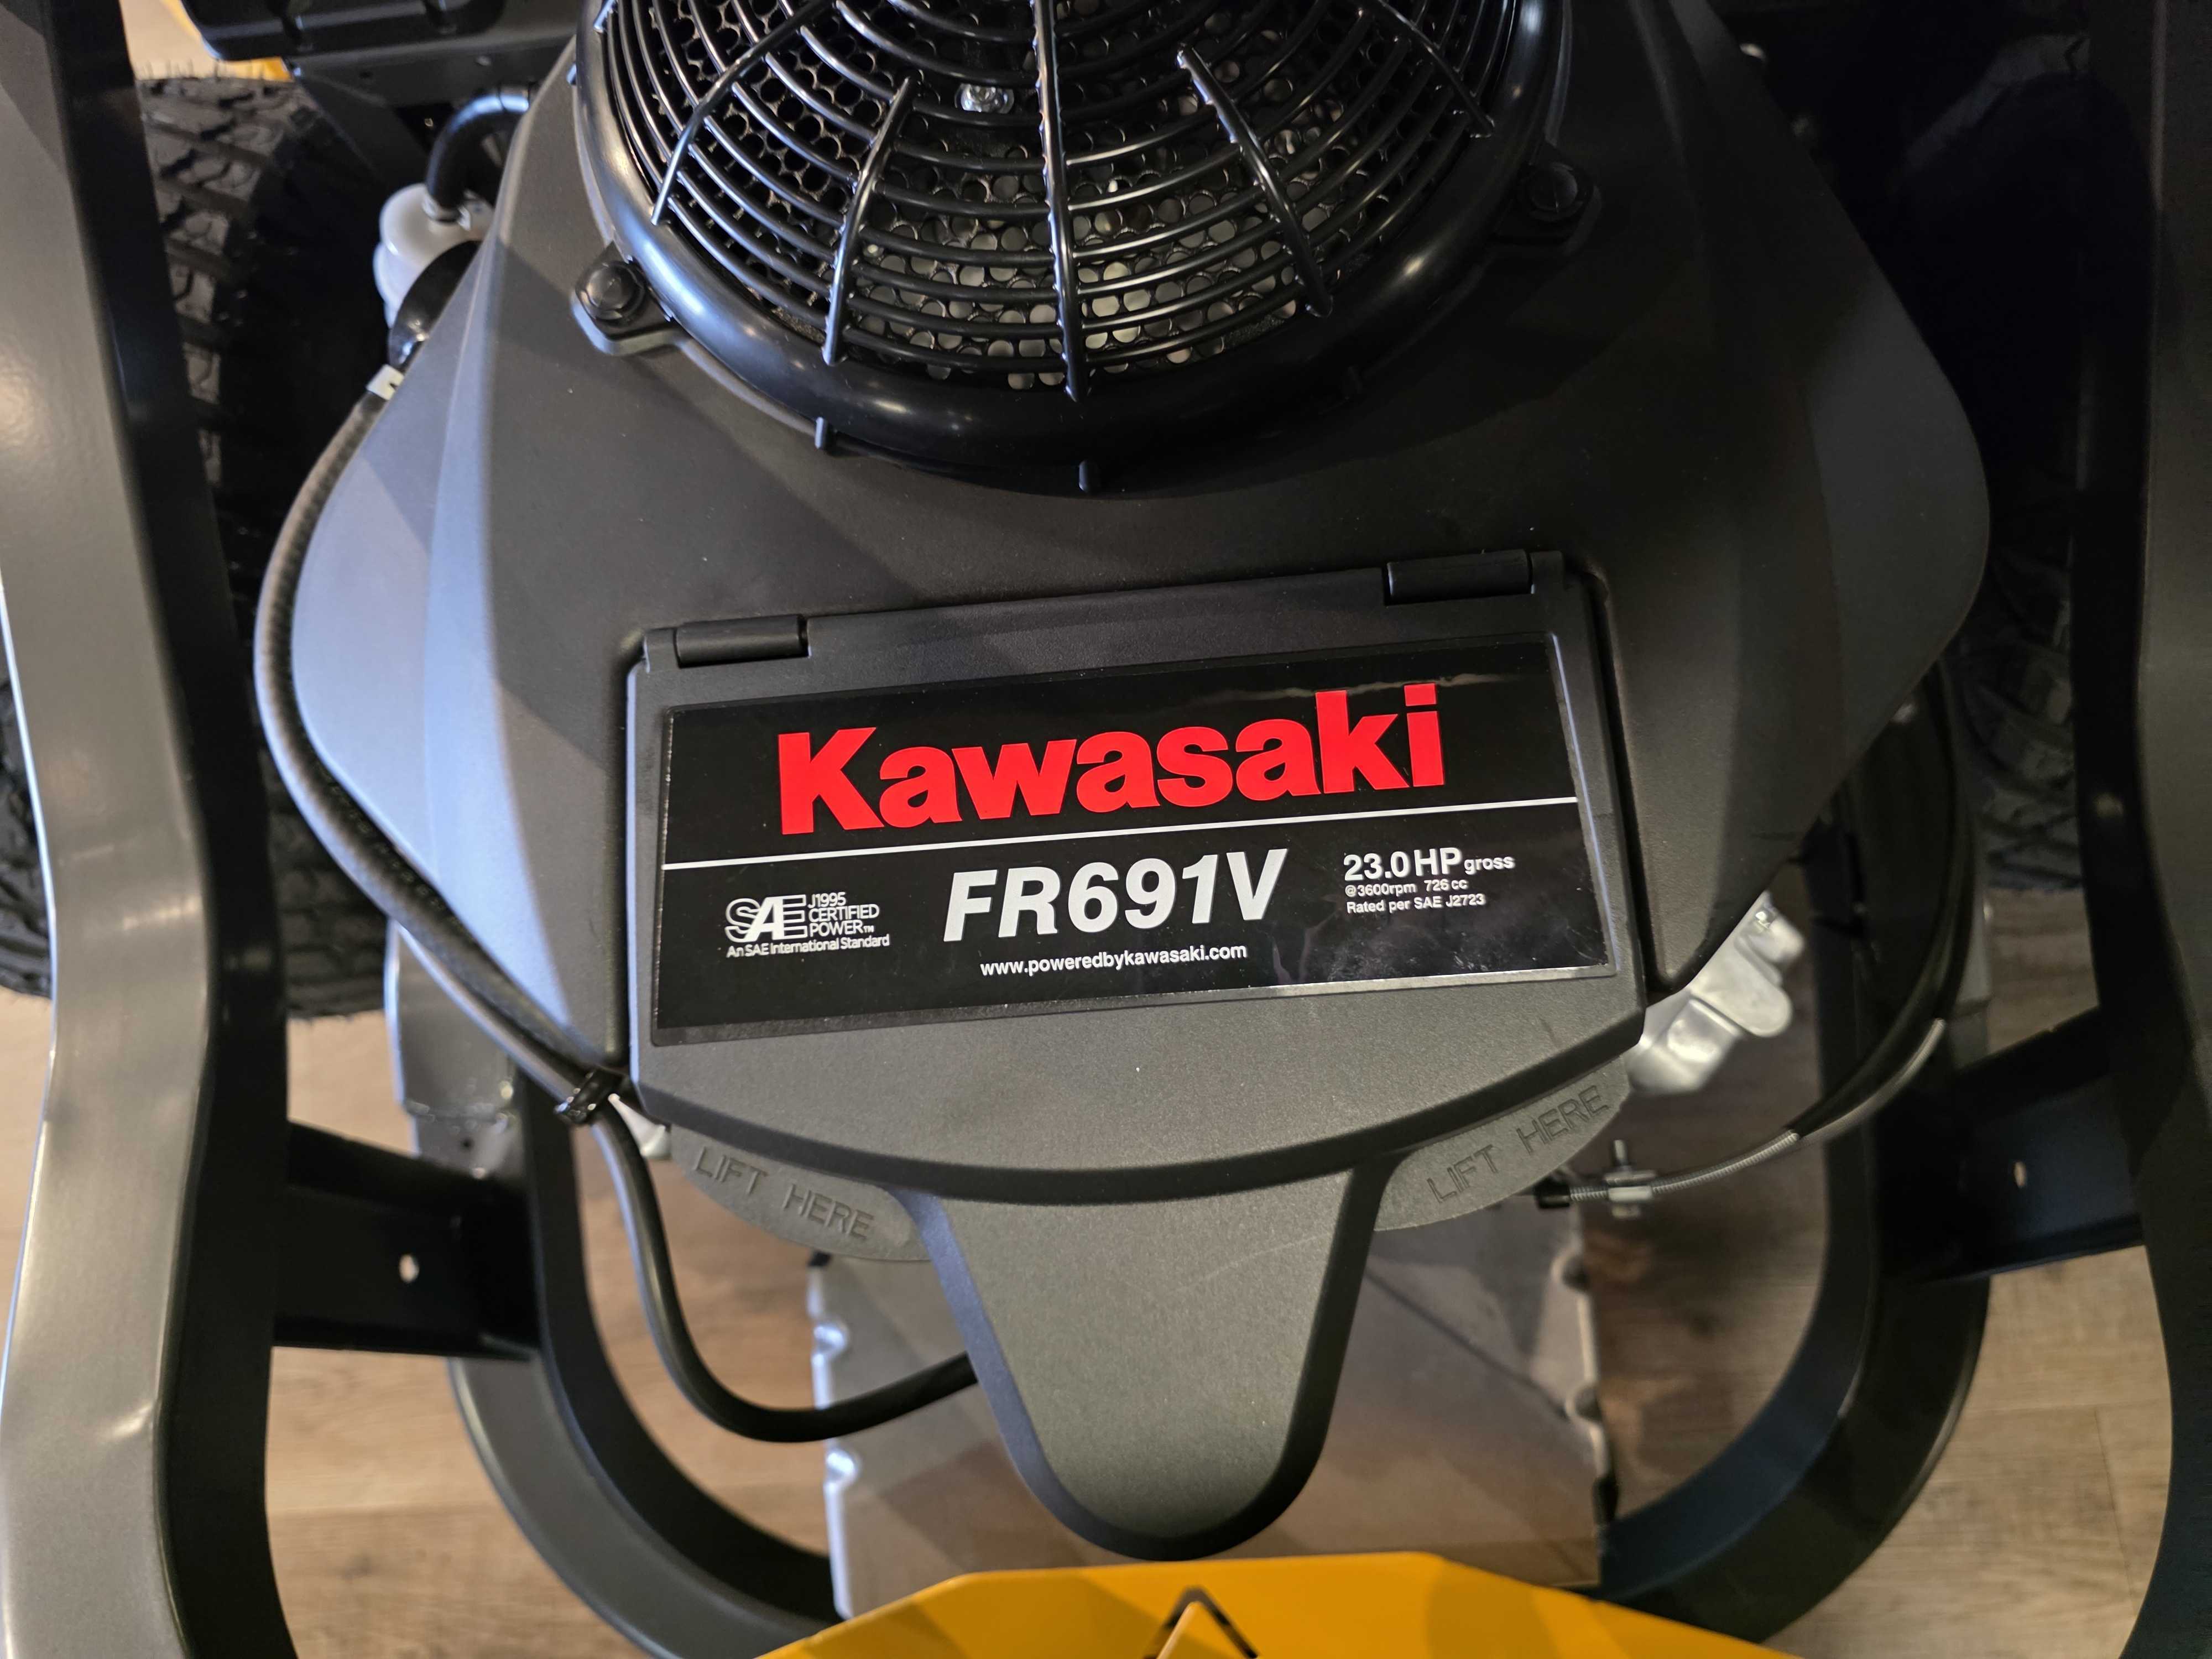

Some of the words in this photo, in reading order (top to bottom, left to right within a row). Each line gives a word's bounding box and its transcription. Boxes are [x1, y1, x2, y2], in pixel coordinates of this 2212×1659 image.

[778, 682, 1445, 836] Kawasaki
[1464, 856, 1515, 875] gross
[807, 892, 847, 909] J1995
[943, 848, 1287, 942] FR691V
[1345, 883, 1417, 897] @3600rpm
[1424, 879, 1449, 892] 726
[1451, 879, 1469, 889] cc
[808, 904, 880, 922] CERTIFIED
[1347, 900, 1386, 914] Rated
[1389, 900, 1411, 913] per
[1413, 895, 1442, 910] SAE
[1446, 893, 1486, 907] J2723
[725, 894, 808, 943] SAE
[726, 945, 744, 958] An
[744, 942, 769, 957] SAE
[770, 937, 839, 955] International
[840, 933, 890, 950] Standard
[980, 944, 1247, 977] www.poweredbykawasaki.com
[1426, 1143, 1500, 1204] LIFT
[1516, 1084, 1610, 1156] HERE
[692, 1146, 769, 1196] LIFT
[781, 1182, 875, 1240] HERE
